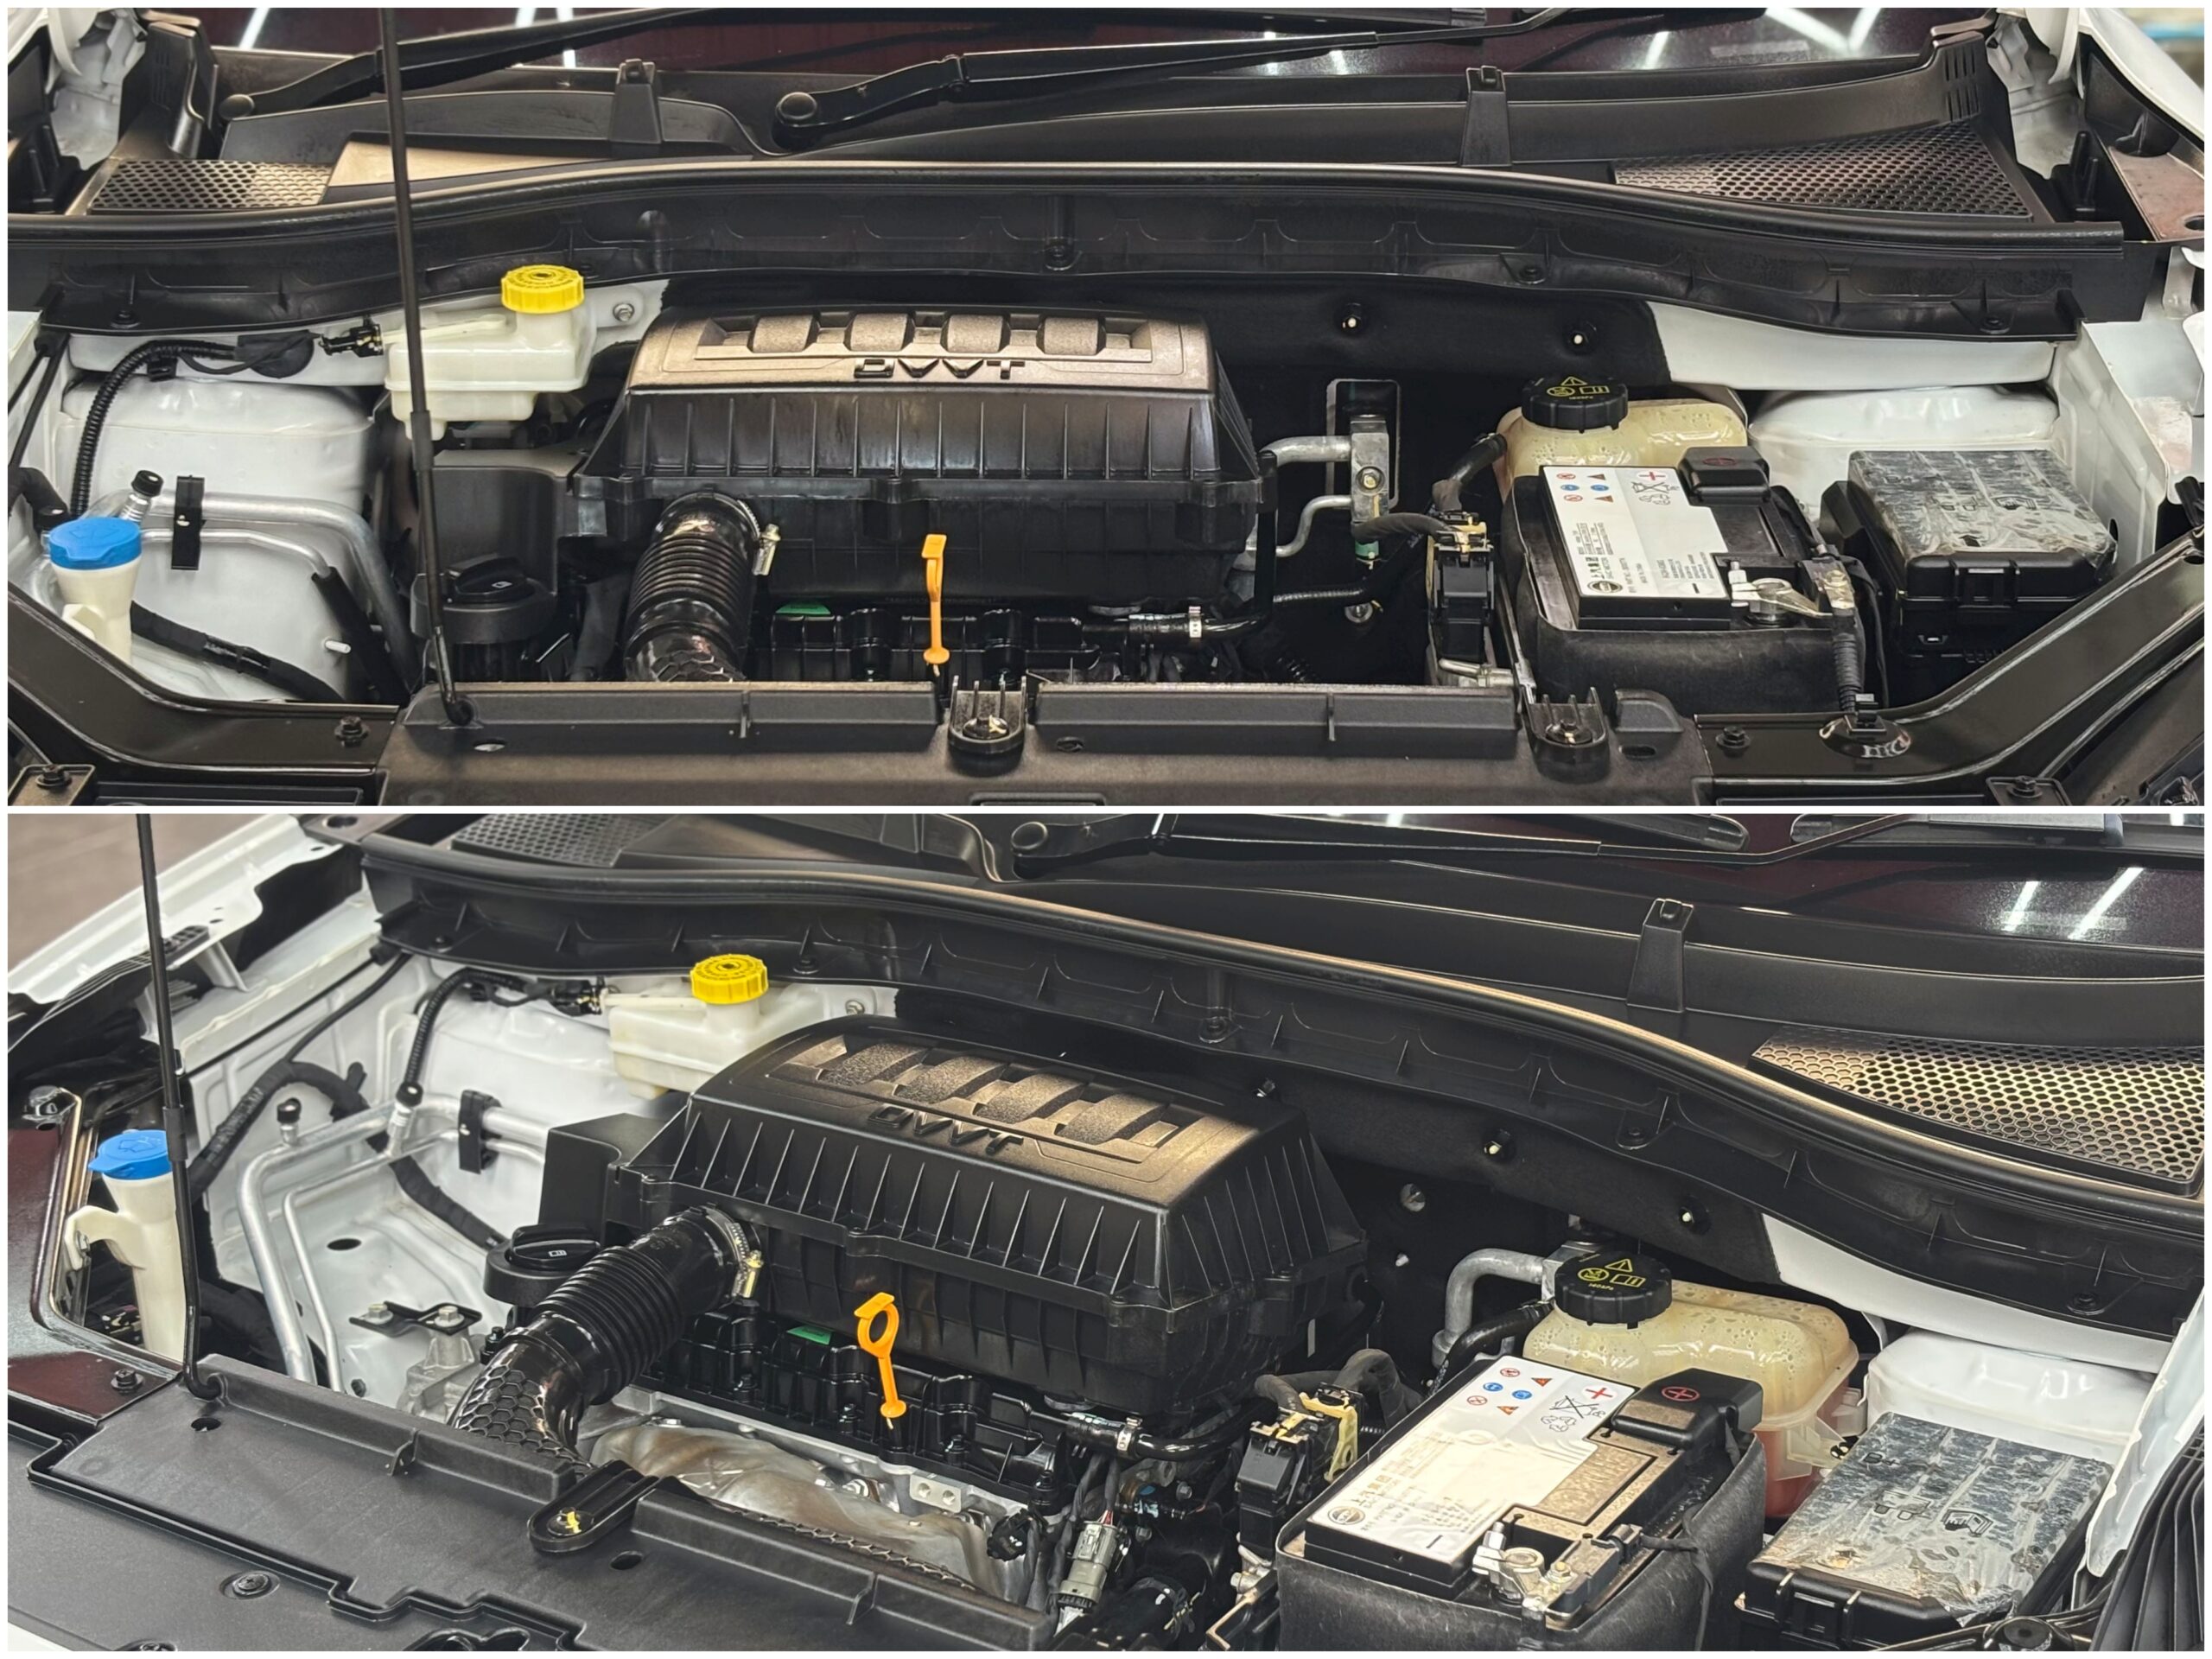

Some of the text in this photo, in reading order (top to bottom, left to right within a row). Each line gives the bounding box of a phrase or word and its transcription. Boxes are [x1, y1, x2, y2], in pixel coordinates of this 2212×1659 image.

[854, 358, 1026, 379] DVVT
[868, 1103, 1024, 1155] DVVT
[1864, 1452, 1900, 1465] B+
